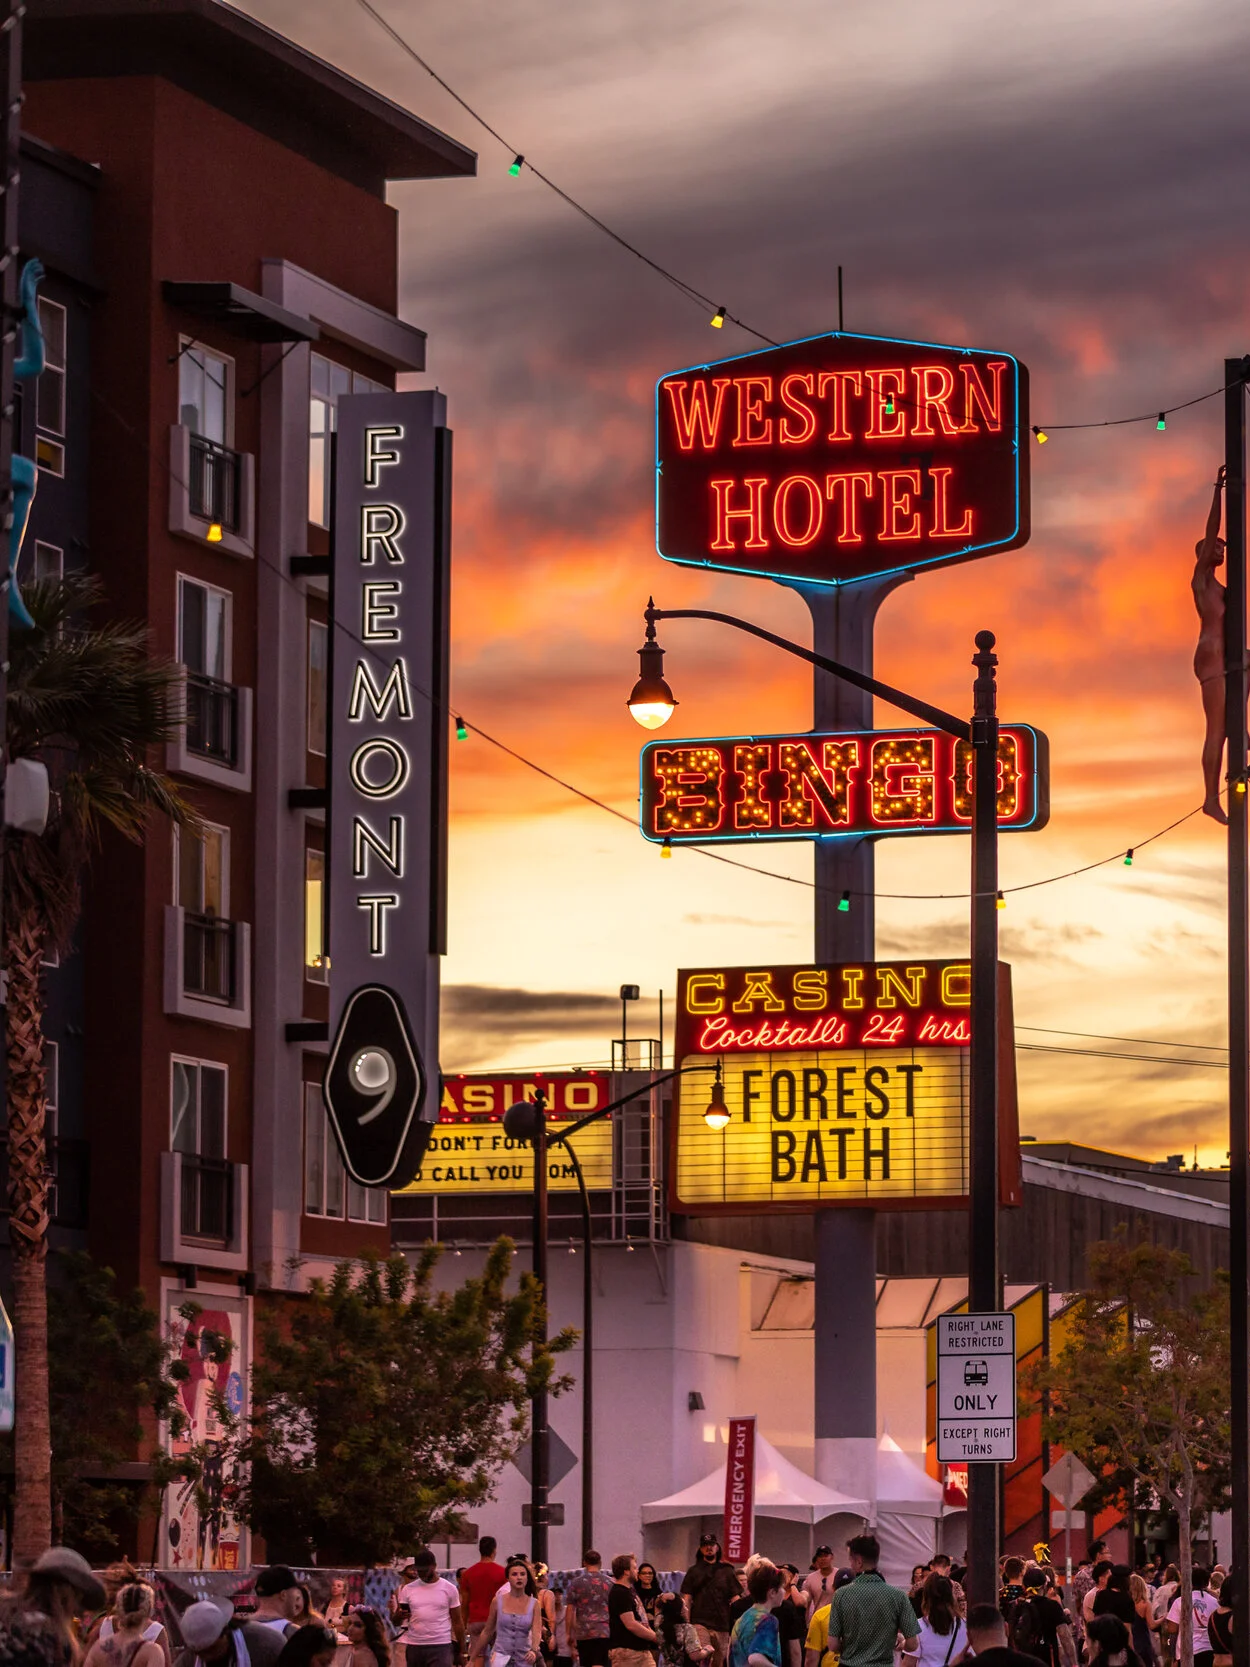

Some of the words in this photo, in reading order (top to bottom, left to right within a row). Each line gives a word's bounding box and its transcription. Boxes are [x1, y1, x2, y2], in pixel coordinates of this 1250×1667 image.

[663, 361, 1008, 451] WESTERN
[710, 466, 974, 551] HOTEL
[348, 425, 413, 958] FREMONT
[654, 733, 1023, 833] BINGO
[686, 964, 971, 1014] CASINO
[860, 1014, 905, 1043] 24
[348, 1045, 398, 1126] 9
[441, 1082, 599, 1112] ASINO
[742, 1064, 923, 1123] FOREST
[427, 1136, 484, 1151] DON'T
[771, 1127, 891, 1183] BATH
[432, 1167, 480, 1181] CALL
[486, 1165, 523, 1180] YOU
[948, 1321, 975, 1332] RIGHT
[981, 1320, 1004, 1331] LANE
[948, 1337, 1004, 1348] RESTRICTED
[954, 1394, 998, 1410] ONLY
[735, 1424, 747, 1458] EXIT
[943, 1428, 978, 1439] EXCEPT
[984, 1427, 1011, 1439] RIGHT
[962, 1444, 993, 1455] TURNS
[728, 1461, 745, 1558] EMERGENCY
